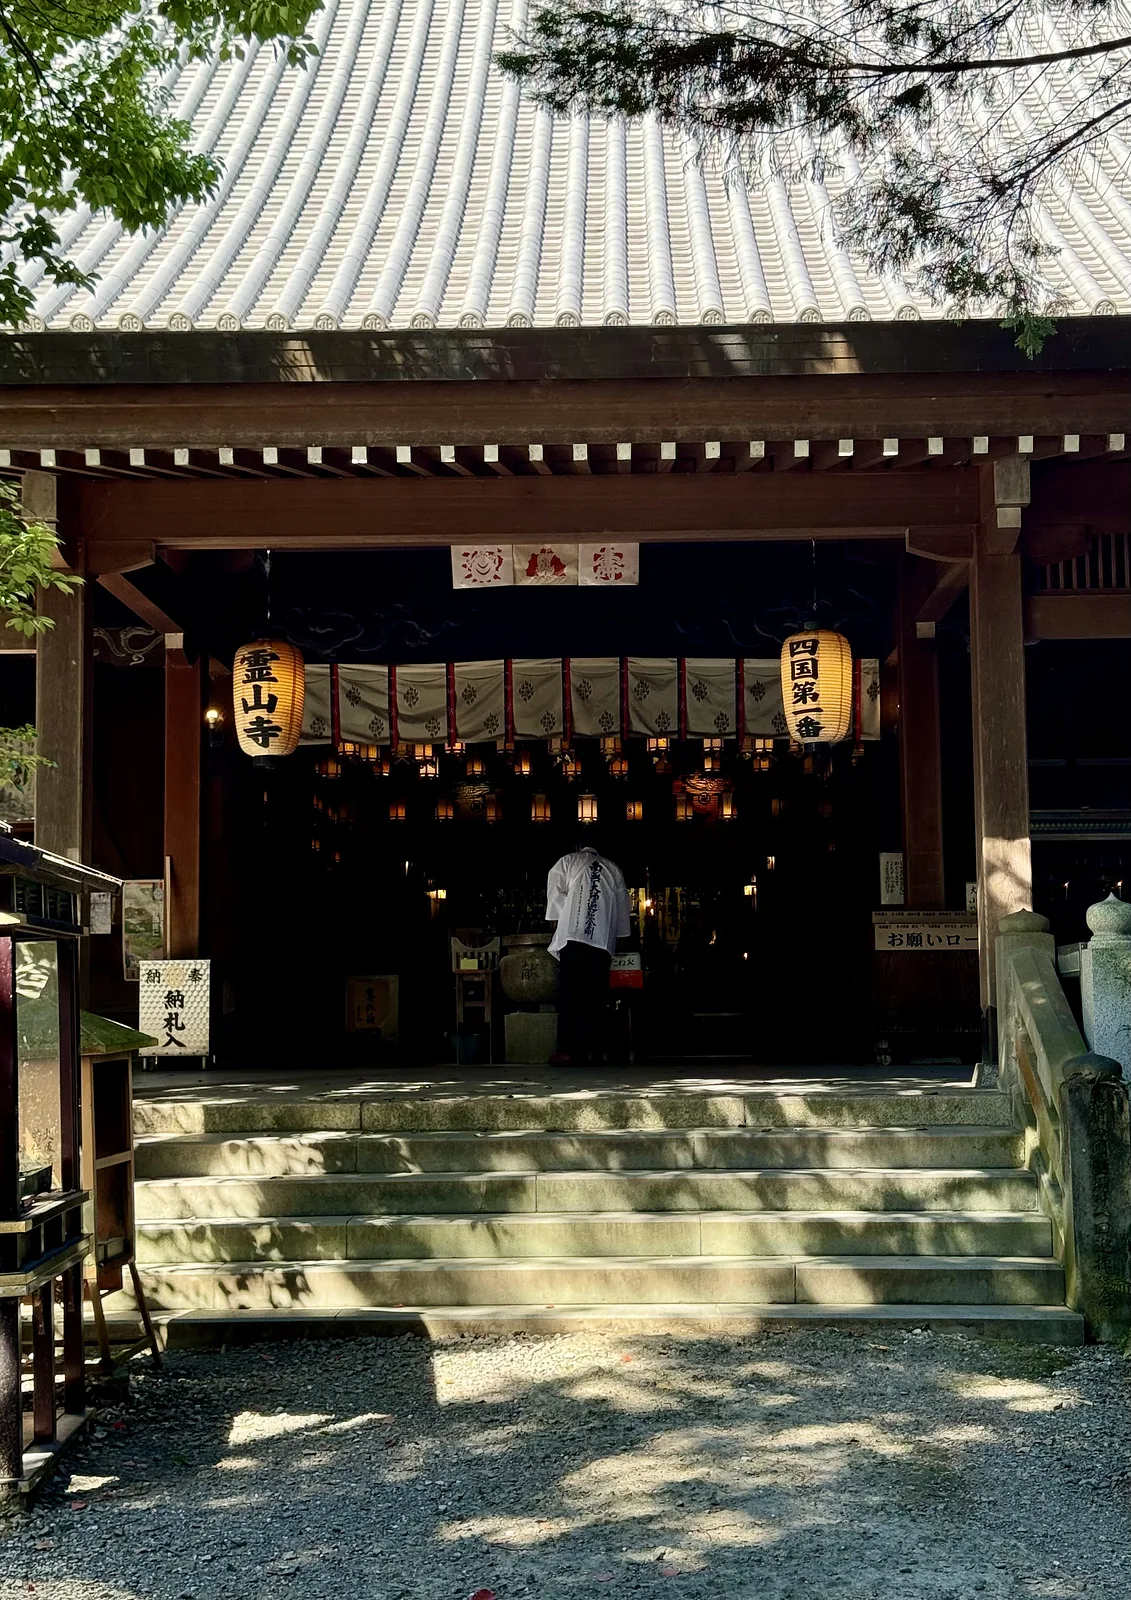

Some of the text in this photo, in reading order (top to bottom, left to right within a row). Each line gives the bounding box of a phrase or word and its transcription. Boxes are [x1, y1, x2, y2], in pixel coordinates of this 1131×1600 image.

[240, 649, 283, 748] 霊山寺
[789, 639, 826, 737] 四国第一番
[145, 968, 204, 984] 奉 納
[162, 989, 187, 1048] 納札入
